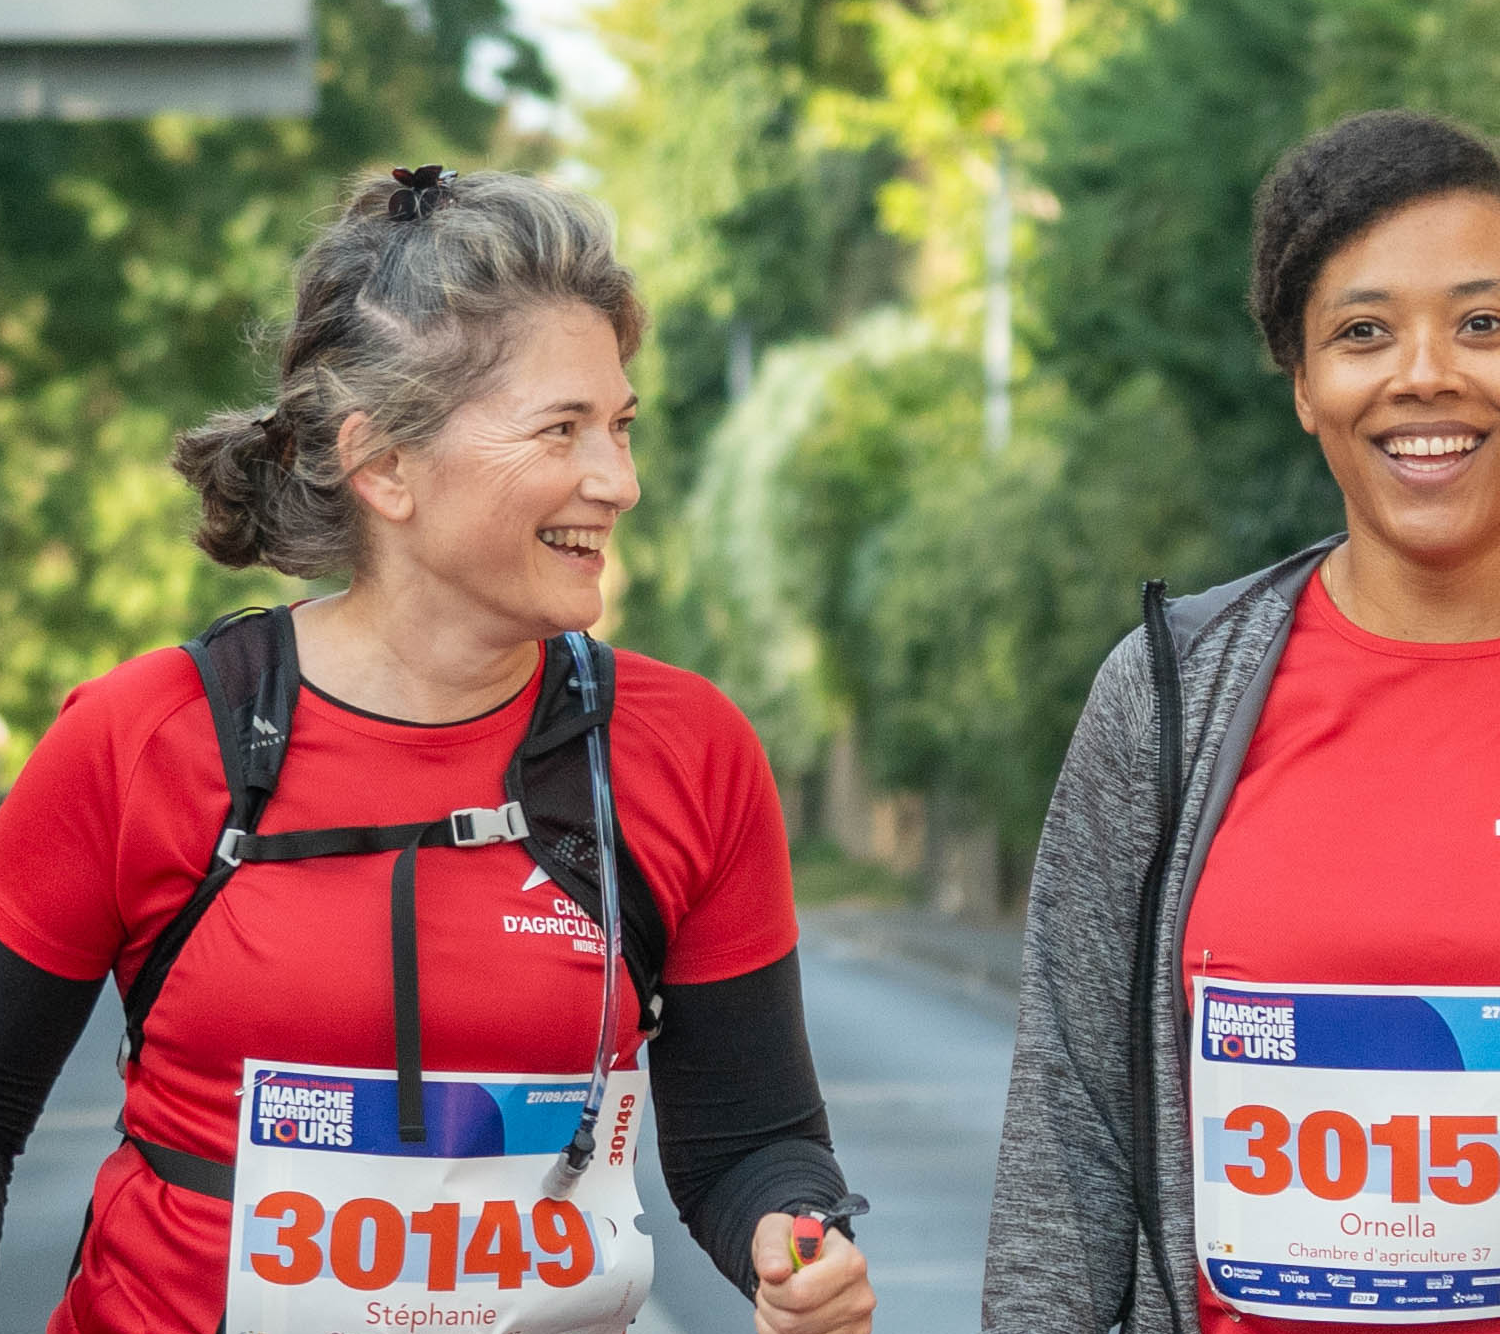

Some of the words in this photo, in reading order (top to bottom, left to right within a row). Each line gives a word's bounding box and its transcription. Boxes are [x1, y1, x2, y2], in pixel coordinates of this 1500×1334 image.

[553, 898, 590, 918] CHA
[1208, 1000, 1295, 1025] MARCHE
[1208, 1018, 1295, 1040] NORDIQUE
[1207, 1034, 1297, 1061] TOURS
[260, 1084, 354, 1110] MARCHE
[259, 1102, 353, 1125] NORDIQUE
[258, 1117, 354, 1147] TOURS
[608, 1093, 637, 1166] 30149
[1340, 1212, 1437, 1238] Ornella
[249, 1191, 597, 1292] 30149
[1288, 1242, 1360, 1261] Chambre
[1363, 1247, 1467, 1267] d'agriculture
[1471, 1247, 1491, 1262] 37
[1279, 1273, 1311, 1285] TOURS
[366, 1300, 497, 1332] Stéphanie
